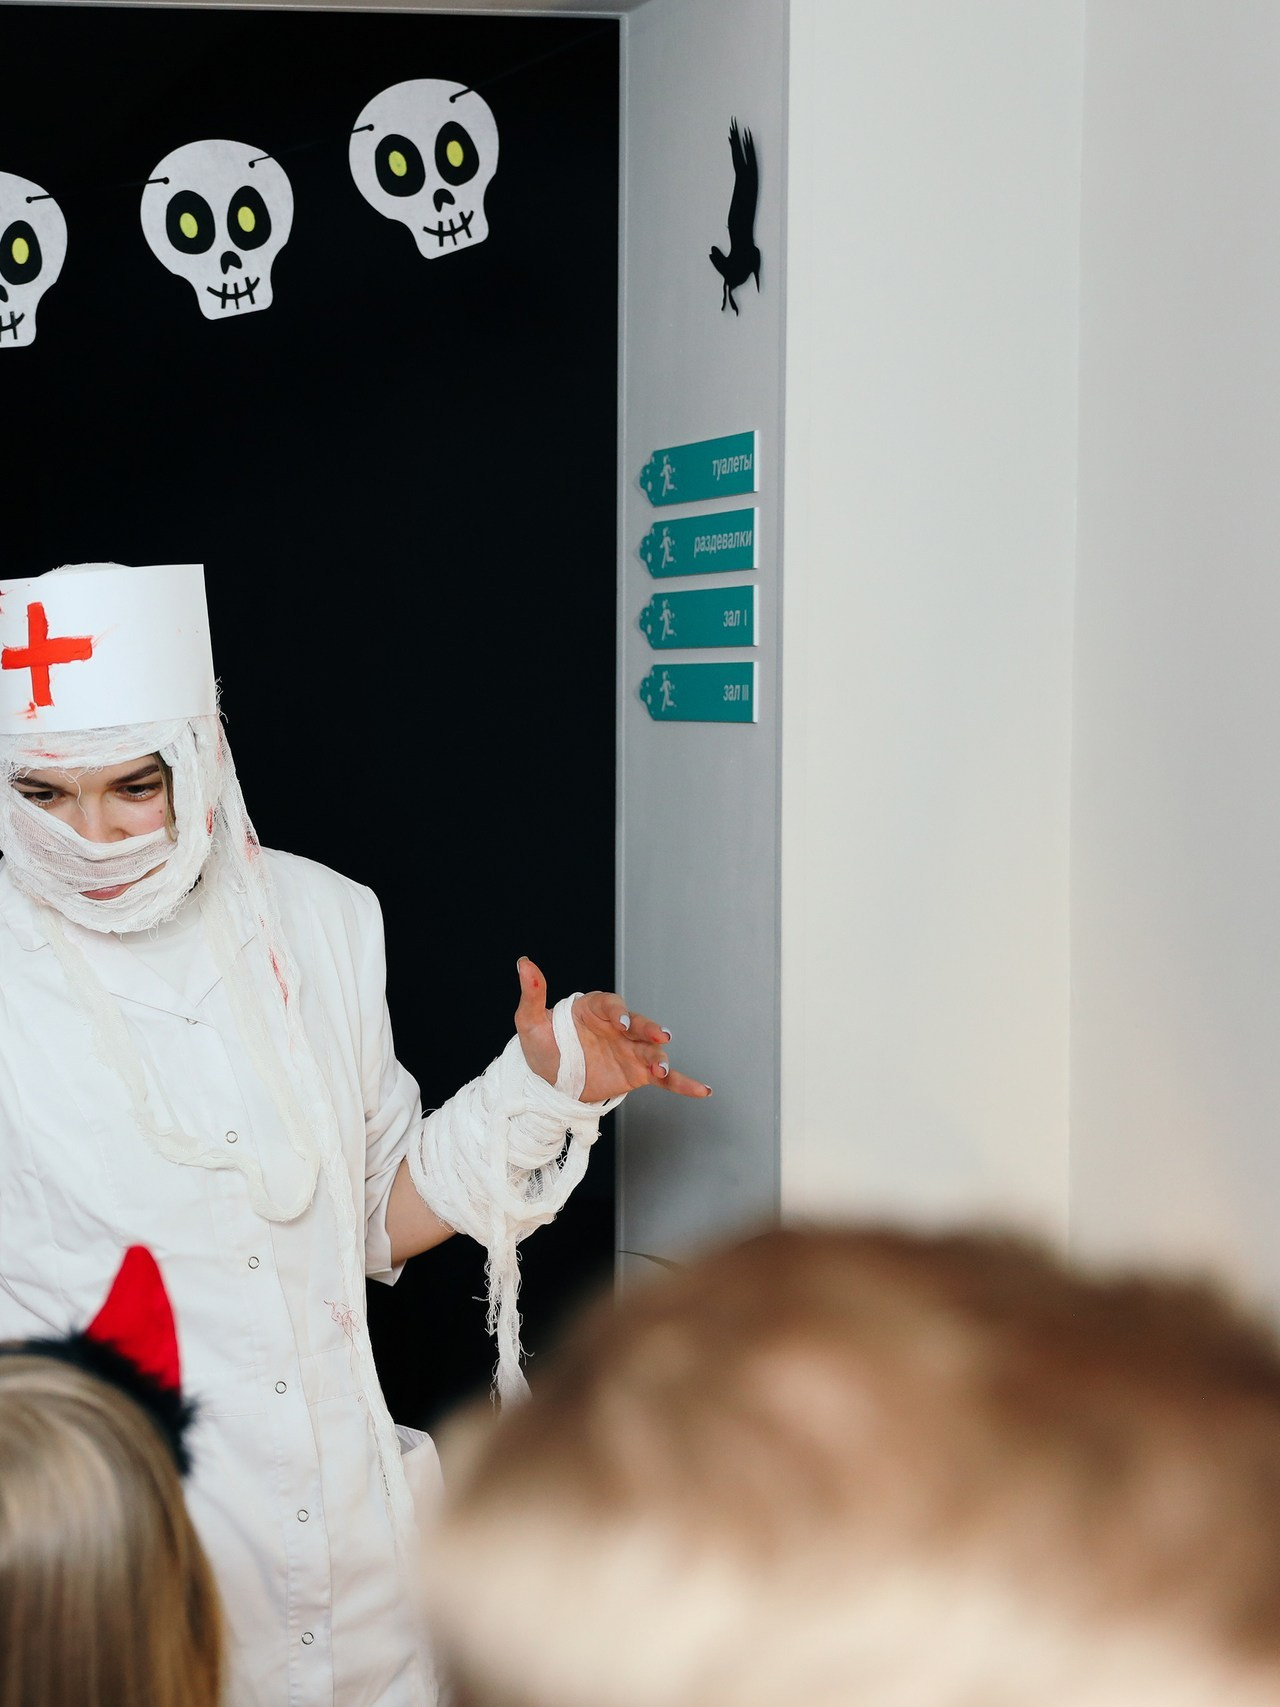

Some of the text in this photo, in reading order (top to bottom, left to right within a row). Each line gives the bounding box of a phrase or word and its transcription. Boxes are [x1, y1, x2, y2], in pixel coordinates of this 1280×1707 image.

[712, 454, 753, 480] туалеты
[694, 530, 752, 558] раздевалки
[723, 610, 740, 627] зал
[723, 684, 740, 701] зал
